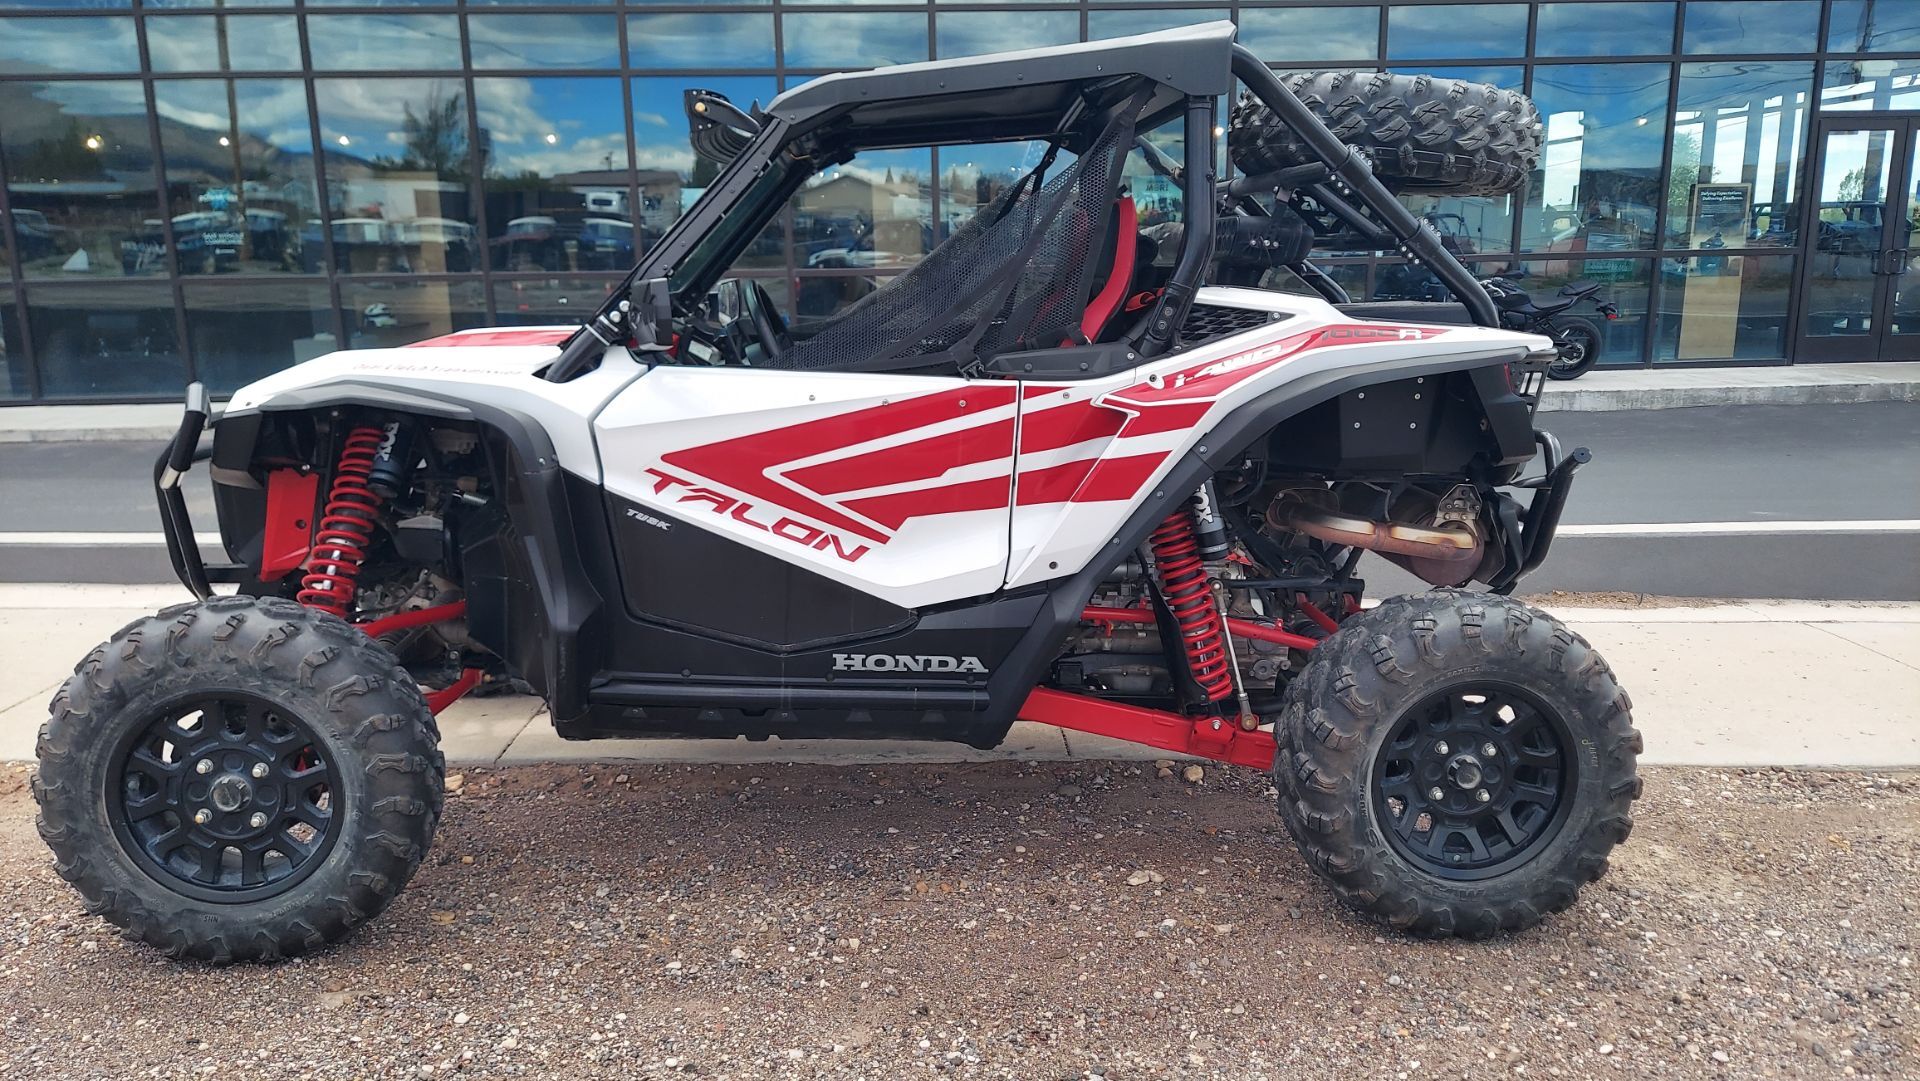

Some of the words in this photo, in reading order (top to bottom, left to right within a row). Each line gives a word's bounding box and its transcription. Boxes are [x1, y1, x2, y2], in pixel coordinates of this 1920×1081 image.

[375, 422, 400, 461] FOX
[626, 507, 672, 531] TUSK
[644, 467, 871, 563] TALON
[1193, 482, 1214, 525] OX
[832, 653, 989, 673] HONDA
